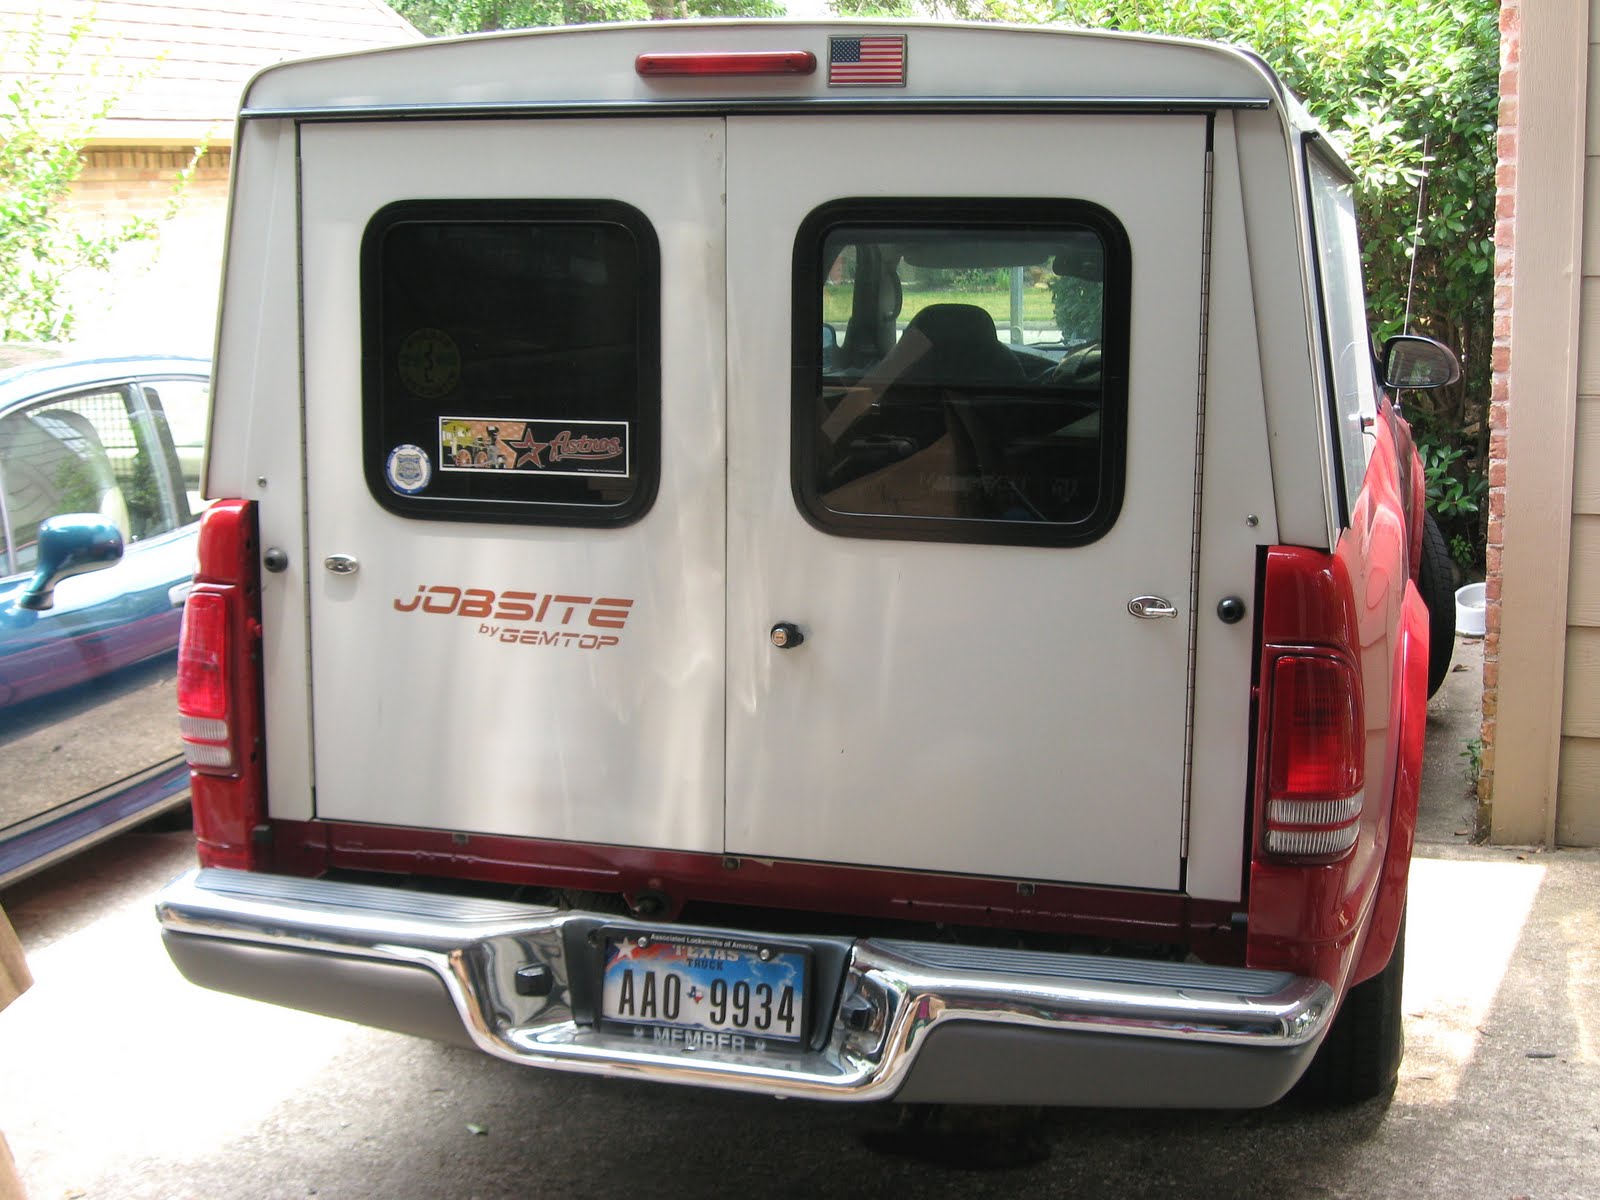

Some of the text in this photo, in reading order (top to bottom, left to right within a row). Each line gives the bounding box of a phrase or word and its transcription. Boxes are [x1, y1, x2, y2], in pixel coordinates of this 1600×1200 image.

[548, 430, 623, 462] Astros
[478, 623, 619, 650] by GEMTOP
[650, 933, 686, 944] Associated
[686, 936, 723, 948] Locksmiths
[731, 941, 758, 951] America
[672, 944, 739, 961] TEXAS
[686, 958, 723, 971] TRUCK
[709, 977, 795, 1034] 9934
[653, 1026, 746, 1052] MEMBER
